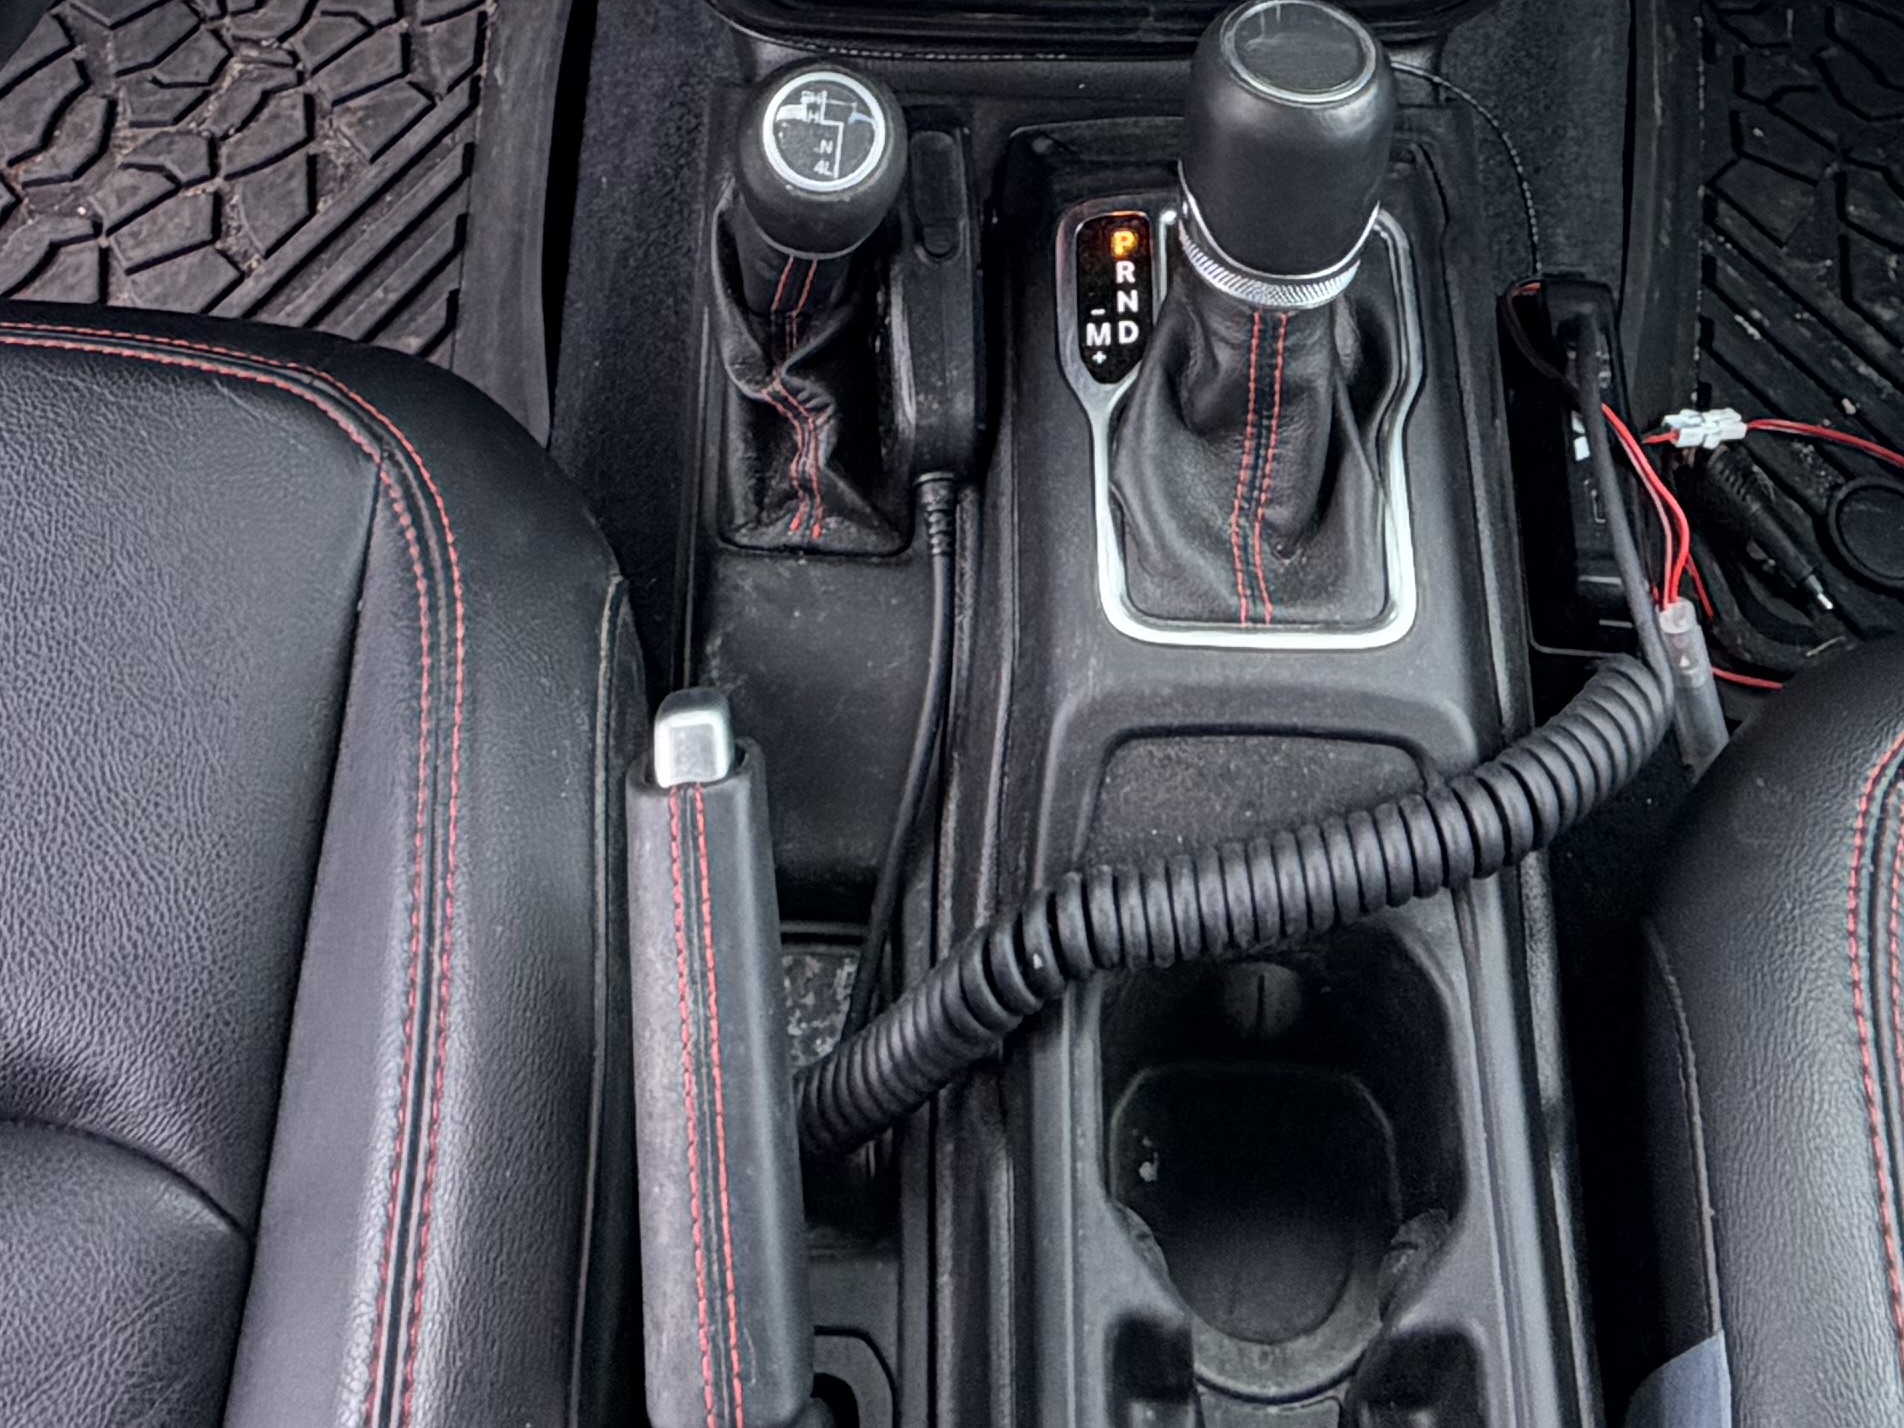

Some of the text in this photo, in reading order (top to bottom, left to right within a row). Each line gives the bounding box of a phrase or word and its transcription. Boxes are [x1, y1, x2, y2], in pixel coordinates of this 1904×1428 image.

[1112, 230, 1137, 257] P
[1116, 260, 1136, 284] R
[1116, 289, 1138, 313] N
[1086, 322, 1112, 347] M
[1118, 320, 1139, 344] D
